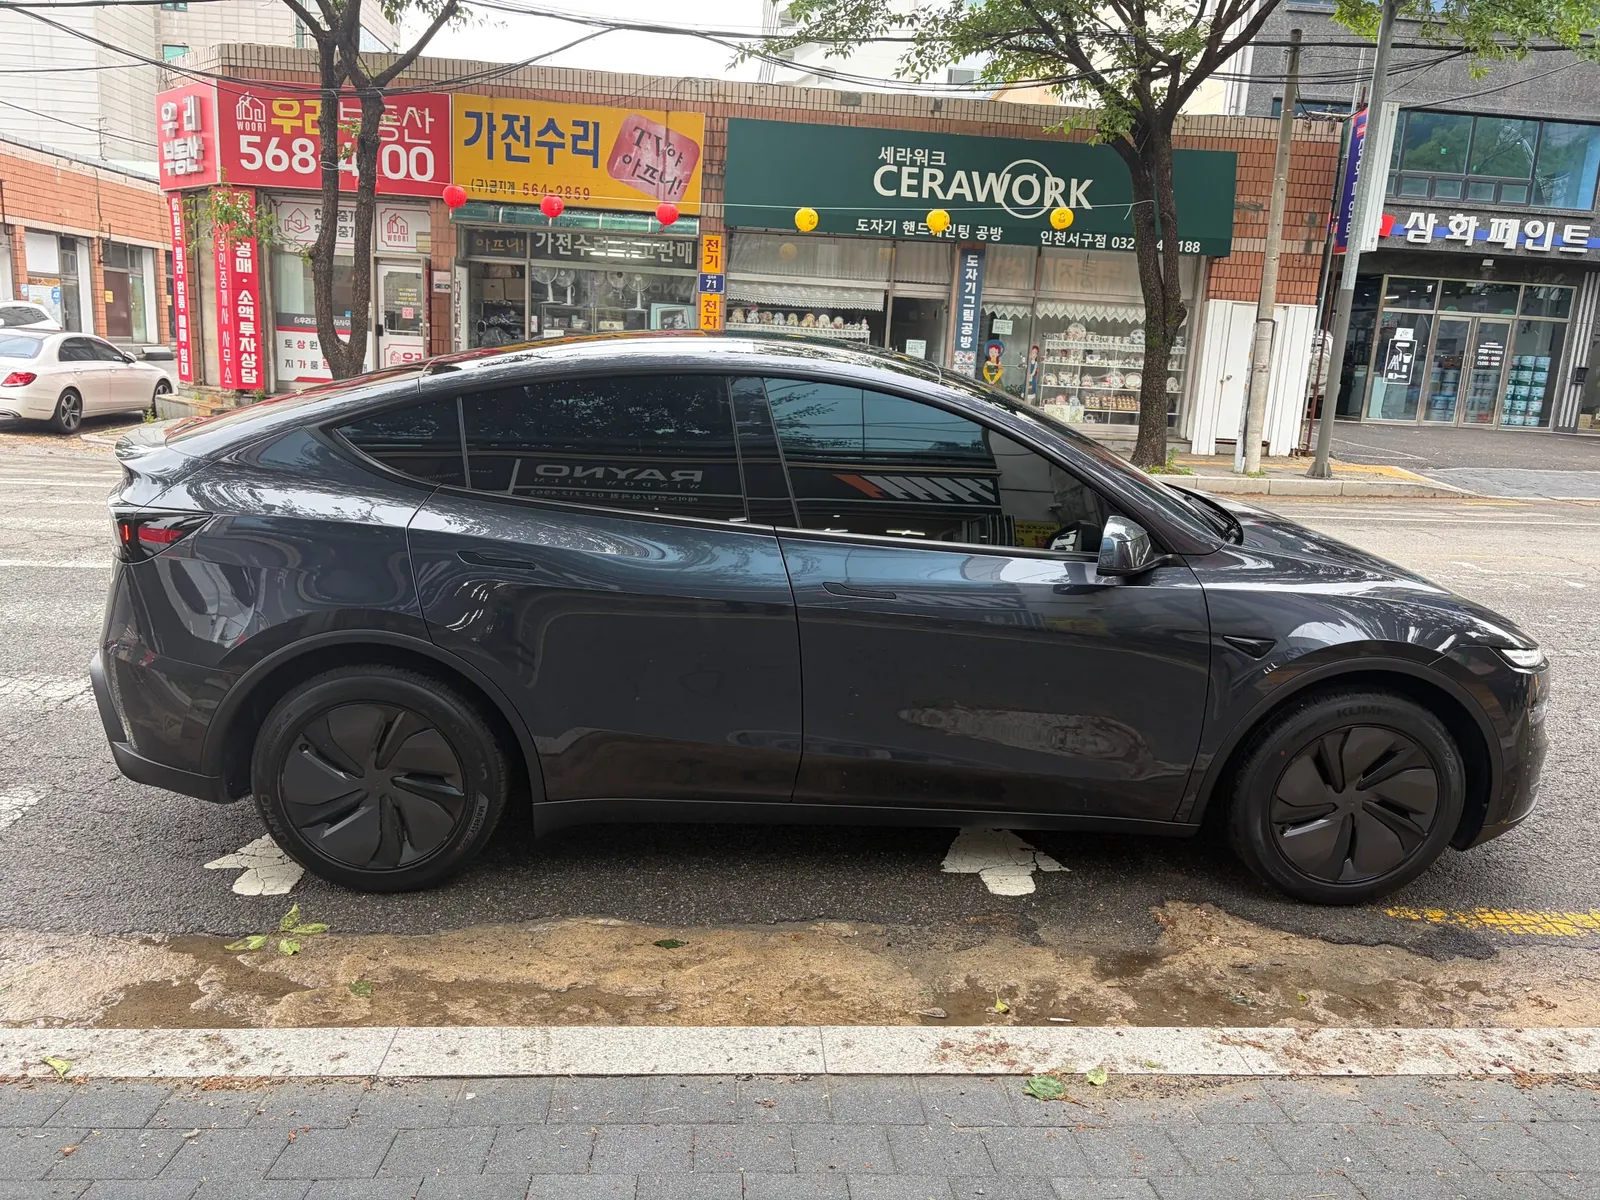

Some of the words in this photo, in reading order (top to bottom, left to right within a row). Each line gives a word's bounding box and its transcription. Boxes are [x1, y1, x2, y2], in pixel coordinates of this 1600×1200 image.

[236, 121, 267, 132] WOORI
[463, 110, 600, 169] 가전수리
[239, 134, 435, 182] 568400
[632, 125, 684, 167] TV야
[877, 145, 947, 167] 세라워크
[521, 182, 591, 201] 564-2859
[872, 164, 1094, 210] CERAWORK
[535, 231, 609, 258] 가전수리
[855, 218, 897, 235] 도자기
[902, 220, 971, 239] 핸드인팅
[975, 225, 1004, 242] 공방
[1040, 230, 1107, 249] 인천서구점
[1403, 211, 1592, 253] 삼화페인트
[704, 239, 719, 269] 전기
[705, 279, 717, 289] 71
[703, 299, 718, 329] 전자
[960, 254, 979, 349] 도자기그림공방
